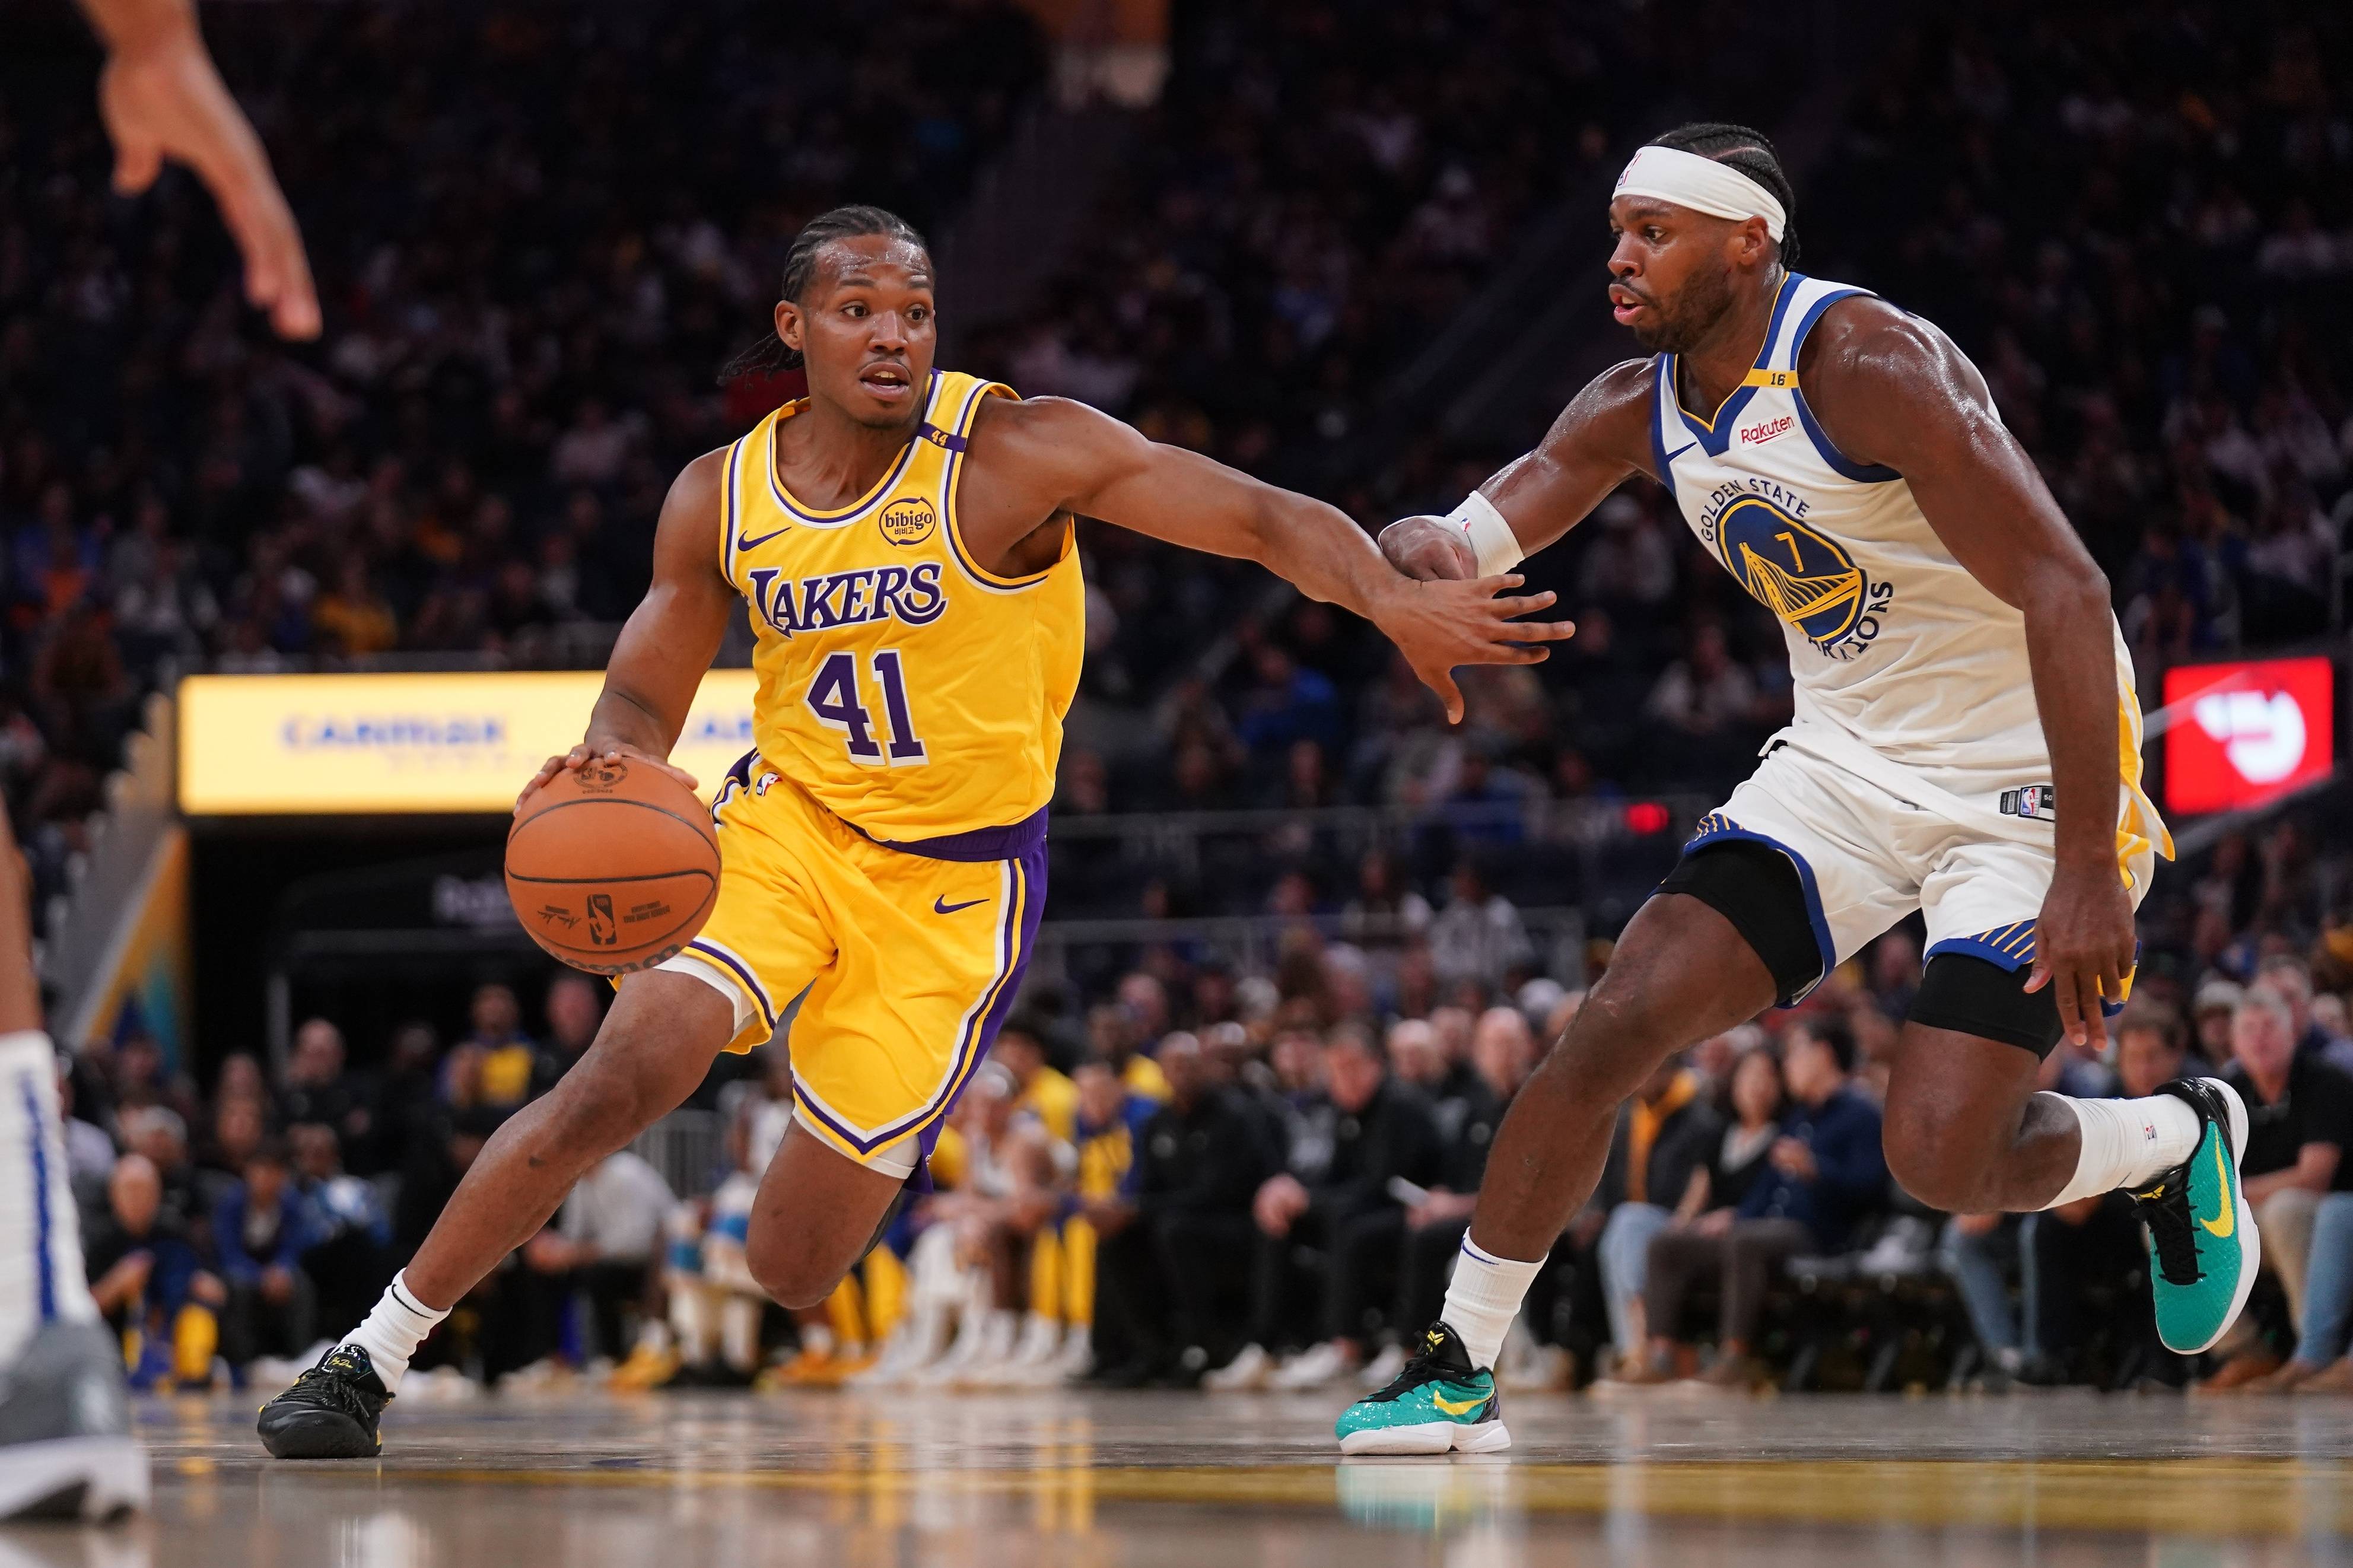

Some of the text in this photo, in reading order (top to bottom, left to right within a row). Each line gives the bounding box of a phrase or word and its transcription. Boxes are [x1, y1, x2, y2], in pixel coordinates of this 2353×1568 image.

[1770, 373, 1786, 386] 16
[931, 430, 949, 447] 44
[1741, 415, 1795, 444] Rakuten
[885, 510, 933, 530] bibigo
[1701, 478, 1810, 542] GOLDEN STATE
[895, 527, 914, 535] 비비고
[1775, 532, 1804, 573] 7
[748, 561, 949, 640] LAKERS
[803, 648, 930, 768] 41
